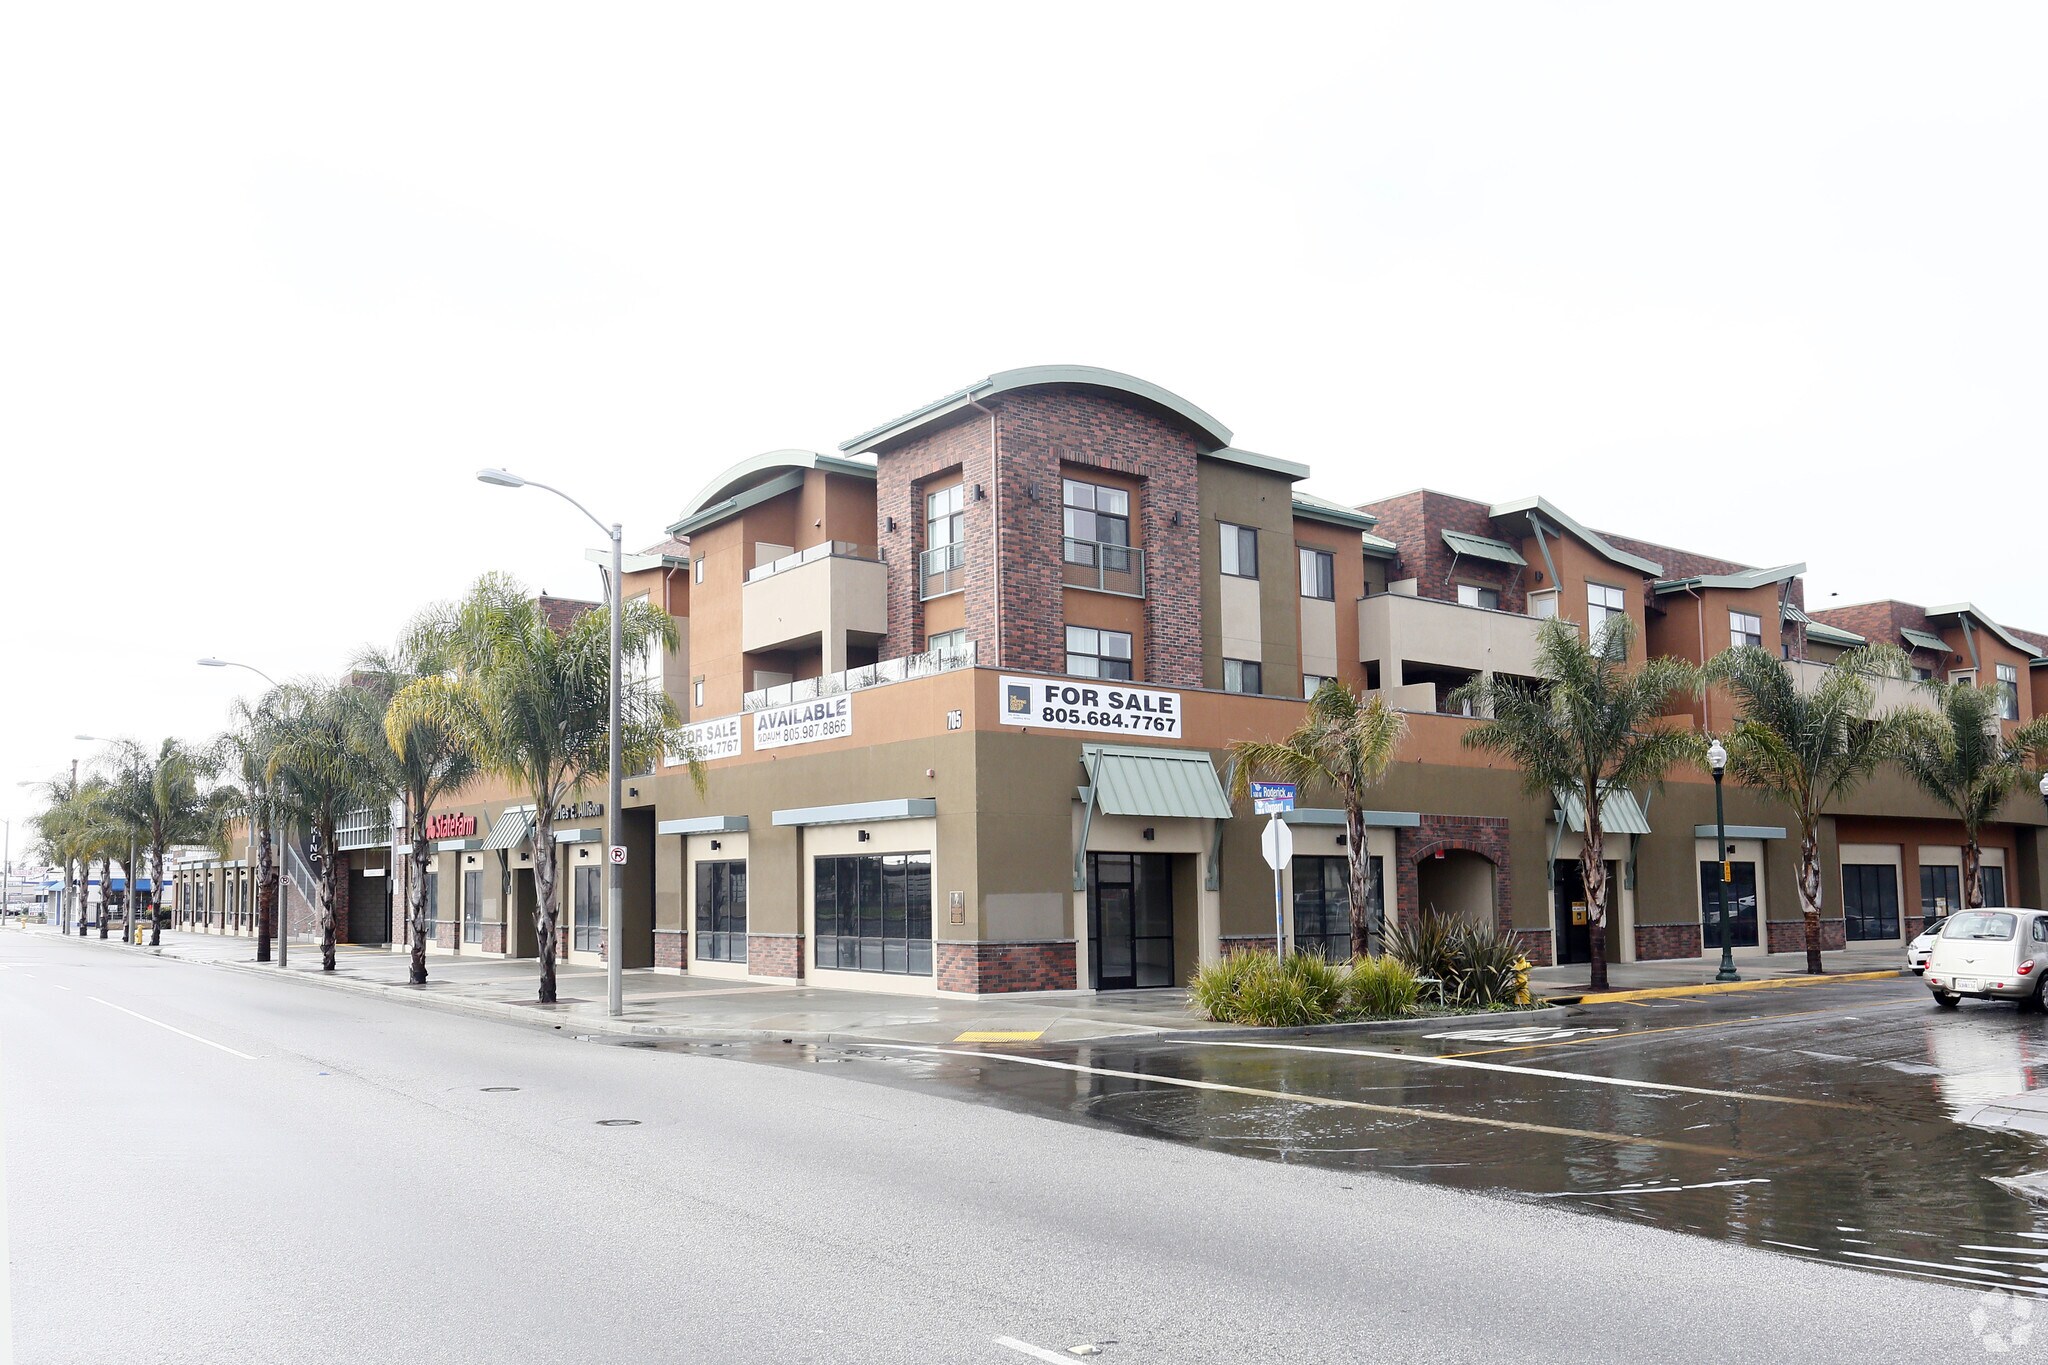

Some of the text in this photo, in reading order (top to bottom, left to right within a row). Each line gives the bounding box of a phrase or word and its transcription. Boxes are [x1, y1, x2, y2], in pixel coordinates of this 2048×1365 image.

[1045, 685, 1099, 707] FOR
[1108, 691, 1173, 714] SALE
[758, 699, 847, 731] AVAILABLE
[1042, 707, 1176, 732] 805.684.7767
[706, 721, 737, 741] SALE
[783, 719, 846, 742] 805.987.8866
[1263, 786, 1286, 798] Roderick
